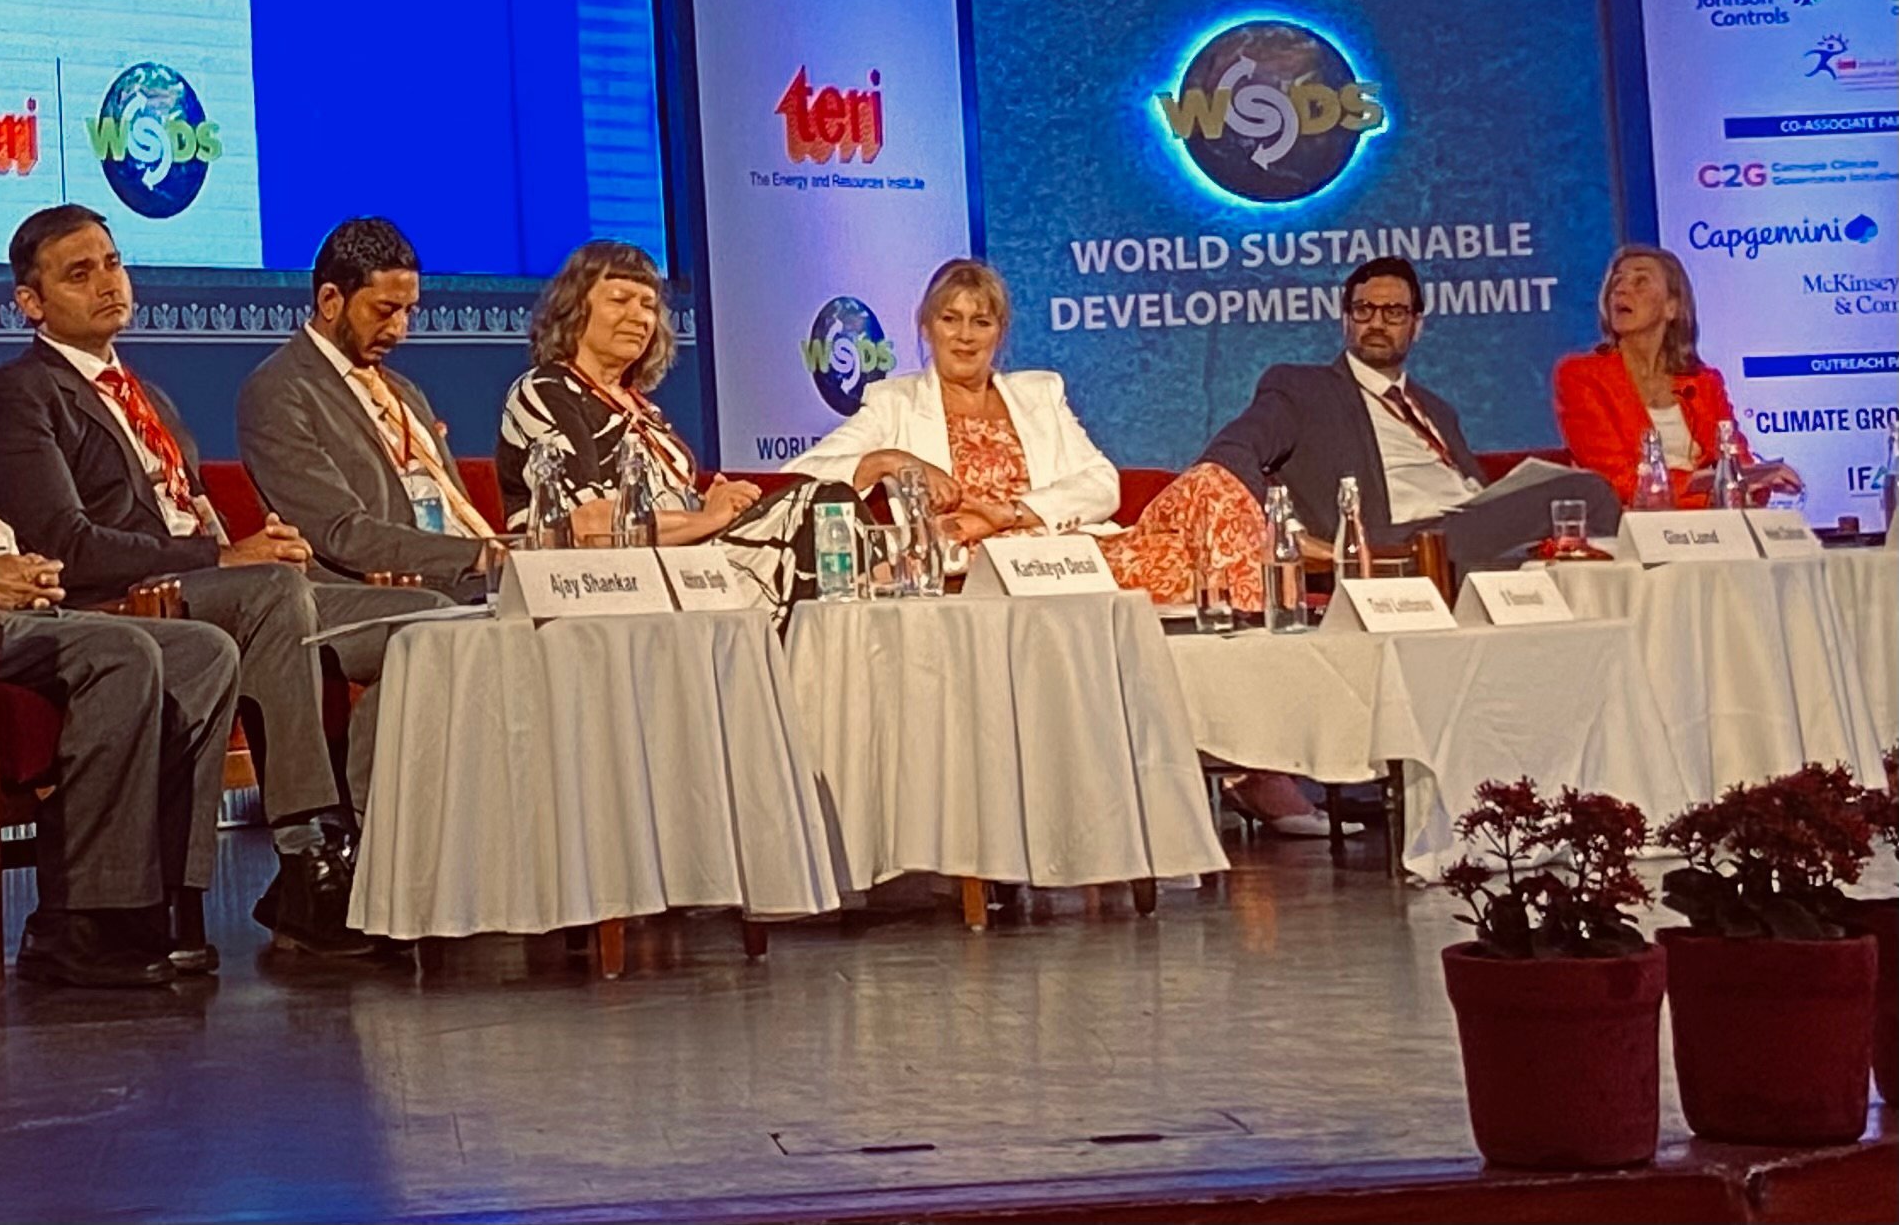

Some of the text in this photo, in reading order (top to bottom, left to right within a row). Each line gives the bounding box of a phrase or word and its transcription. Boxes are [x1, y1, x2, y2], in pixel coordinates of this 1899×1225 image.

[1710, 8, 1790, 27] Controls
[774, 64, 884, 165] teri
[1780, 116, 1876, 133] CO-ASSOCIATE
[1698, 163, 1767, 188] C2G
[1071, 222, 1534, 275] WORLD SUSTAINABLE
[1689, 218, 1842, 260] Capgemini
[1803, 273, 1899, 295] McKinsey
[1050, 278, 1558, 332] DEVELOPMEN UMMIT
[1835, 296, 1853, 315] &
[1811, 356, 1885, 372] OUTREACH
[1756, 407, 1850, 434] CLIMATE
[550, 572, 638, 599] Ajay Shankar
